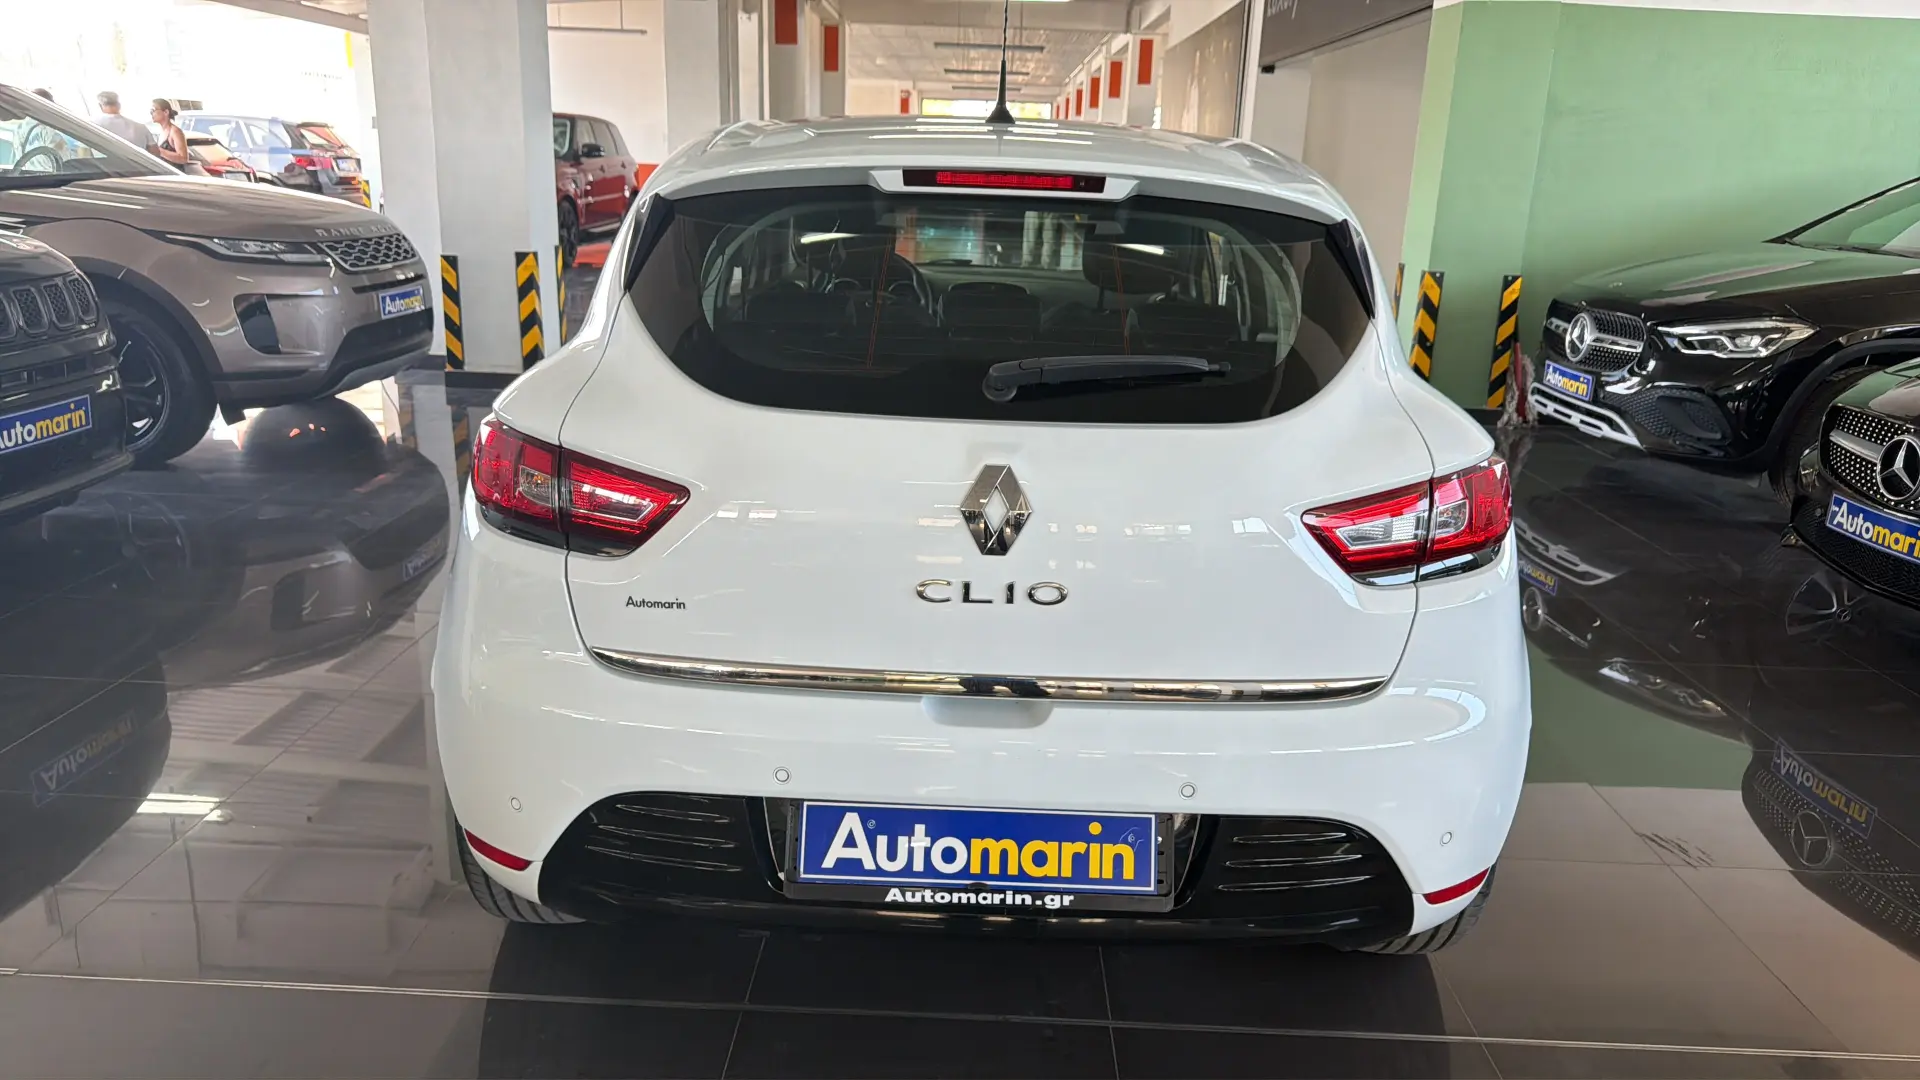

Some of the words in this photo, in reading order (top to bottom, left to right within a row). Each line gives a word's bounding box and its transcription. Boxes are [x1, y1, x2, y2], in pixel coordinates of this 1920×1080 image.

[1832, 501, 1920, 559] Automari
[626, 595, 686, 610] Automarin
[916, 579, 1069, 605] CLIO
[821, 812, 1134, 880] Automarin
[884, 887, 1074, 909] Automarin.gr
